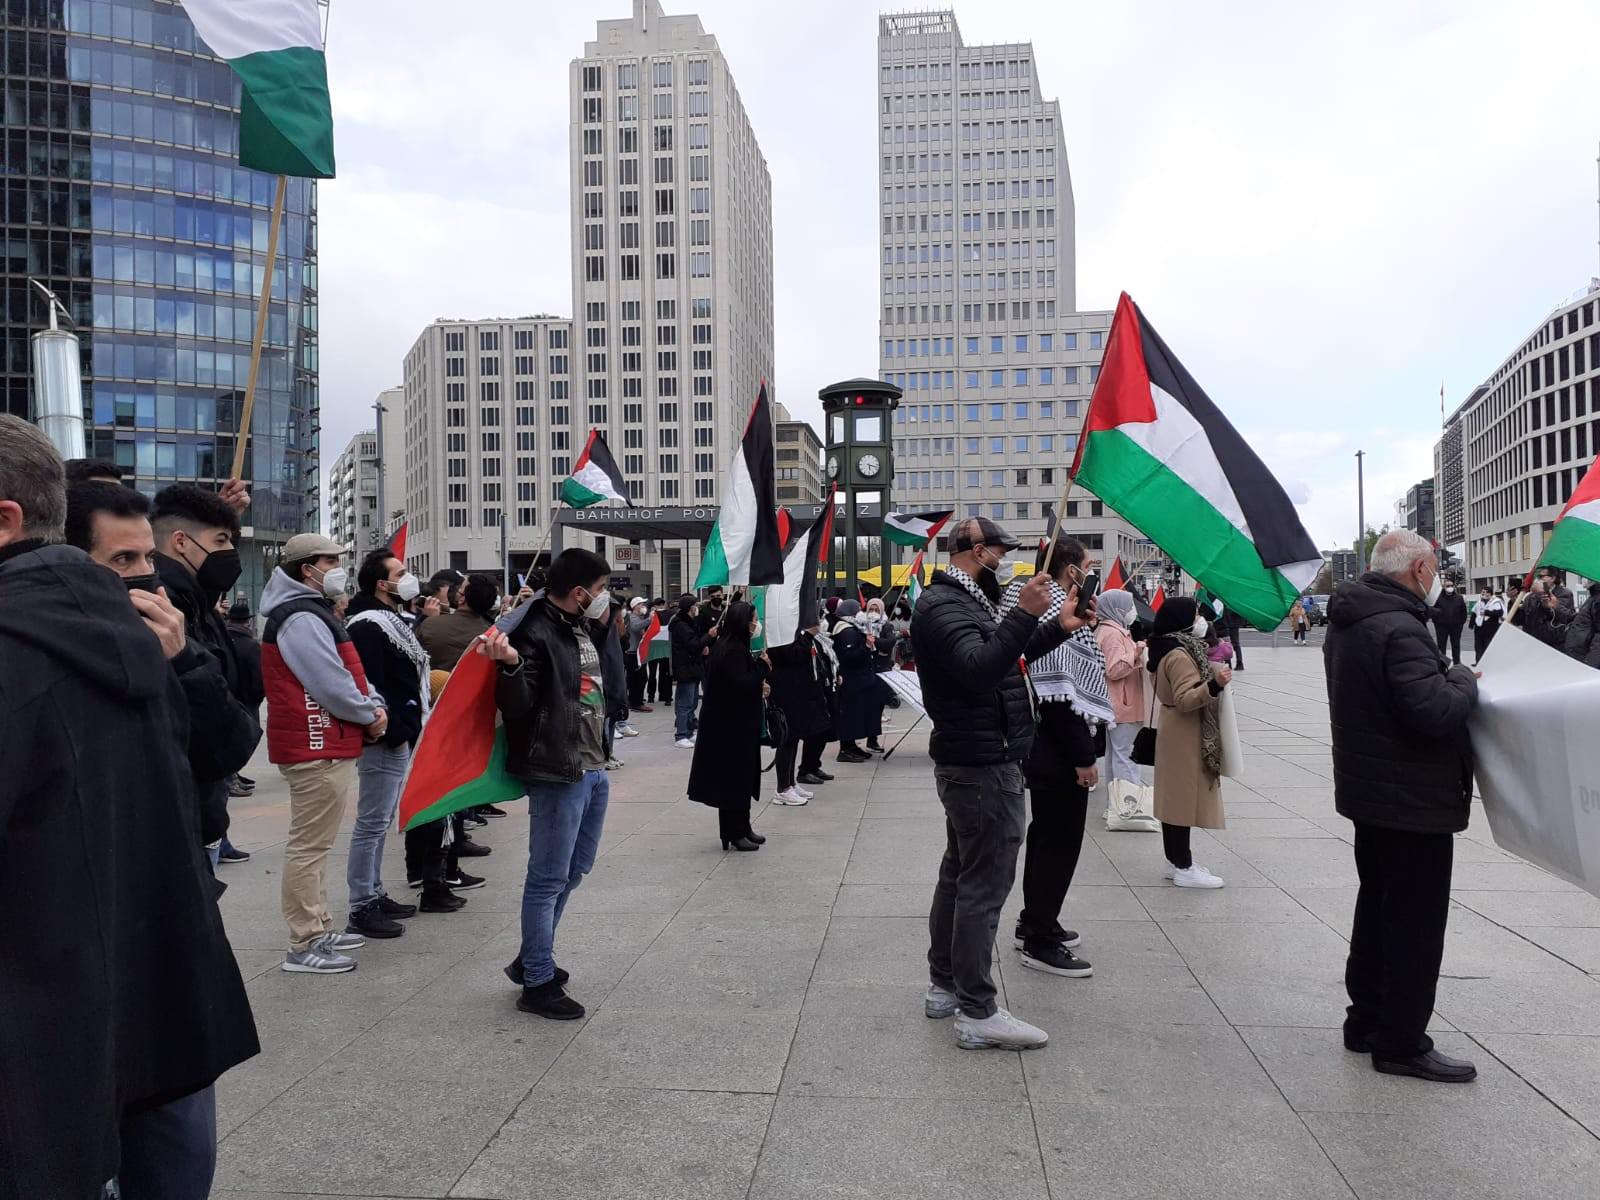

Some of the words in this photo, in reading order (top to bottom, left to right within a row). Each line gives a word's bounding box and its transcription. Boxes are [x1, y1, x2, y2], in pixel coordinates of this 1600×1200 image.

[575, 509, 663, 520] BAHNHOF
[812, 505, 870, 516] PAZ
[617, 549, 630, 559] DB
[320, 708, 332, 728] SON
[307, 714, 324, 750] CLUB
